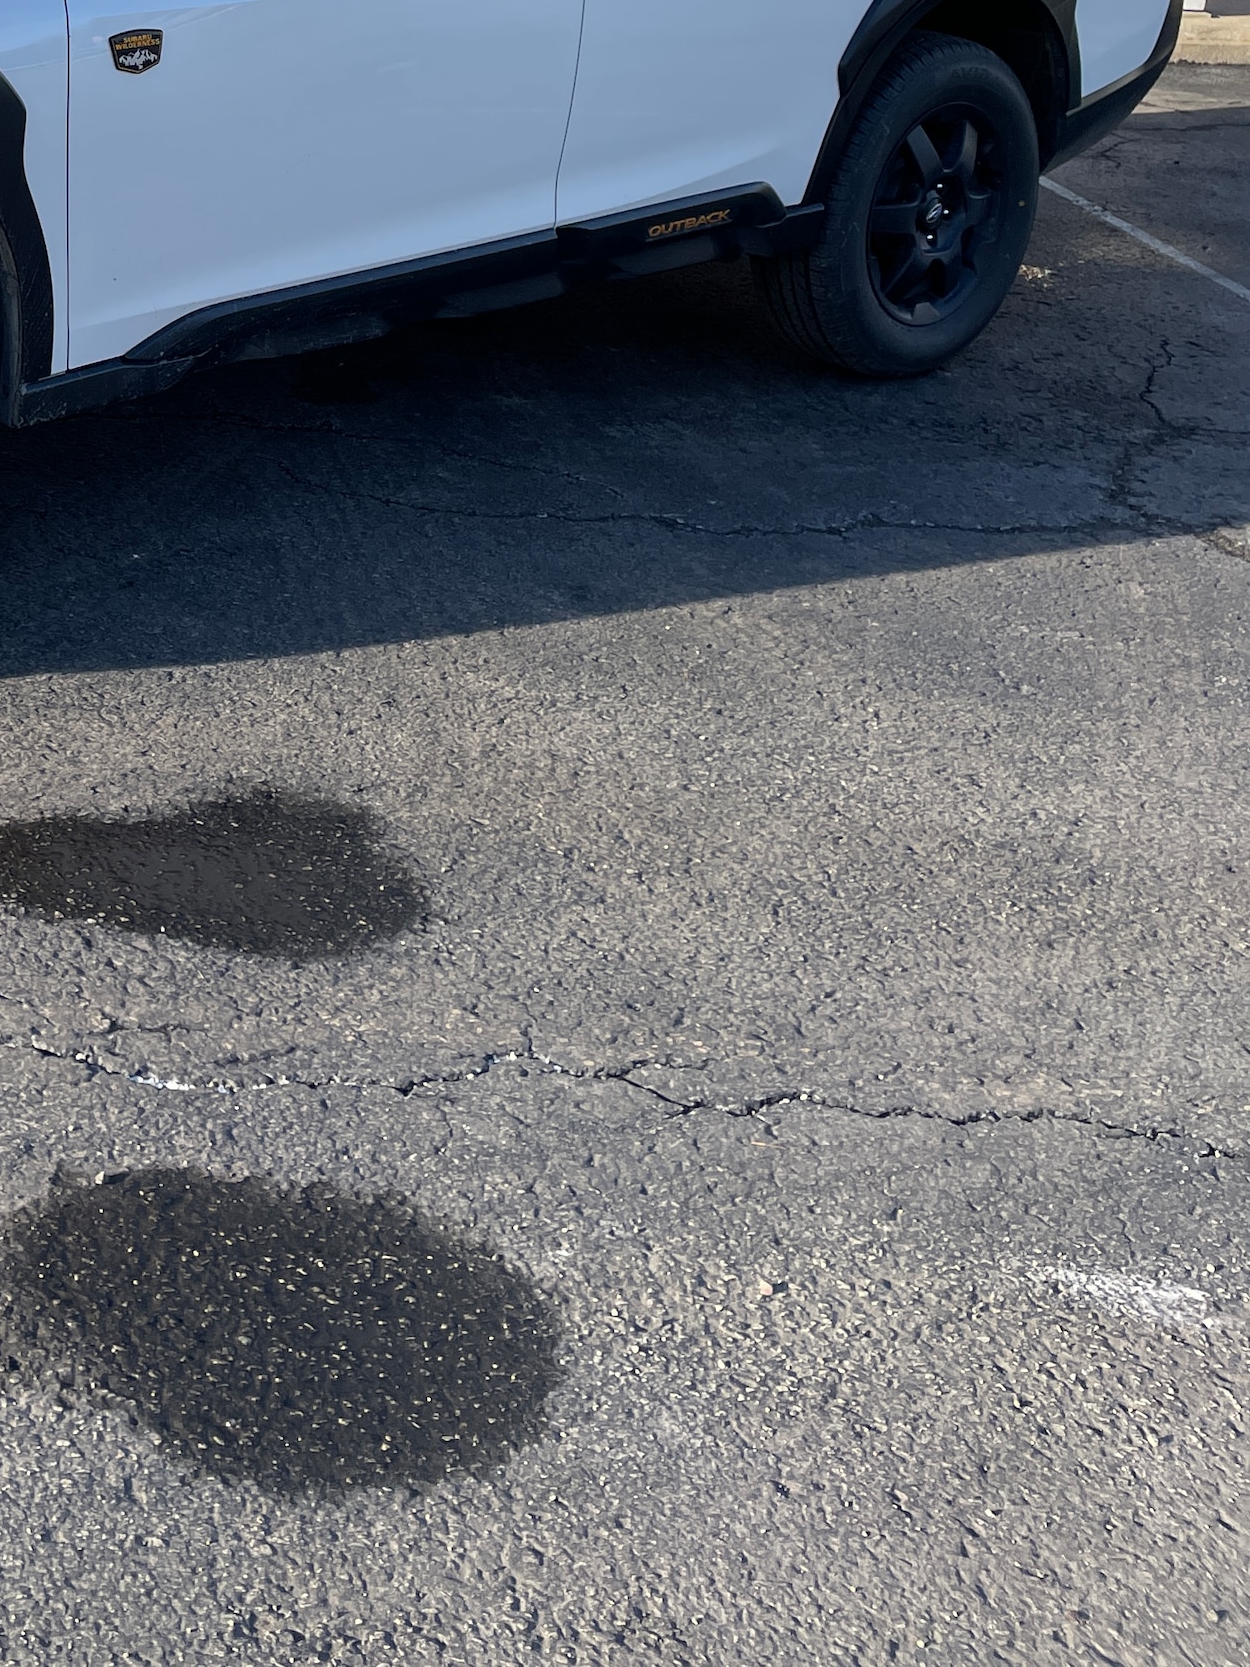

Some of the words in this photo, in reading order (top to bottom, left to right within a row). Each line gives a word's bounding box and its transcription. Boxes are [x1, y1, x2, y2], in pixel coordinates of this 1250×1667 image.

[115, 38, 161, 51] WILDERNESS
[123, 34, 152, 44] SUBARU
[648, 209, 731, 237] OUTBACK
